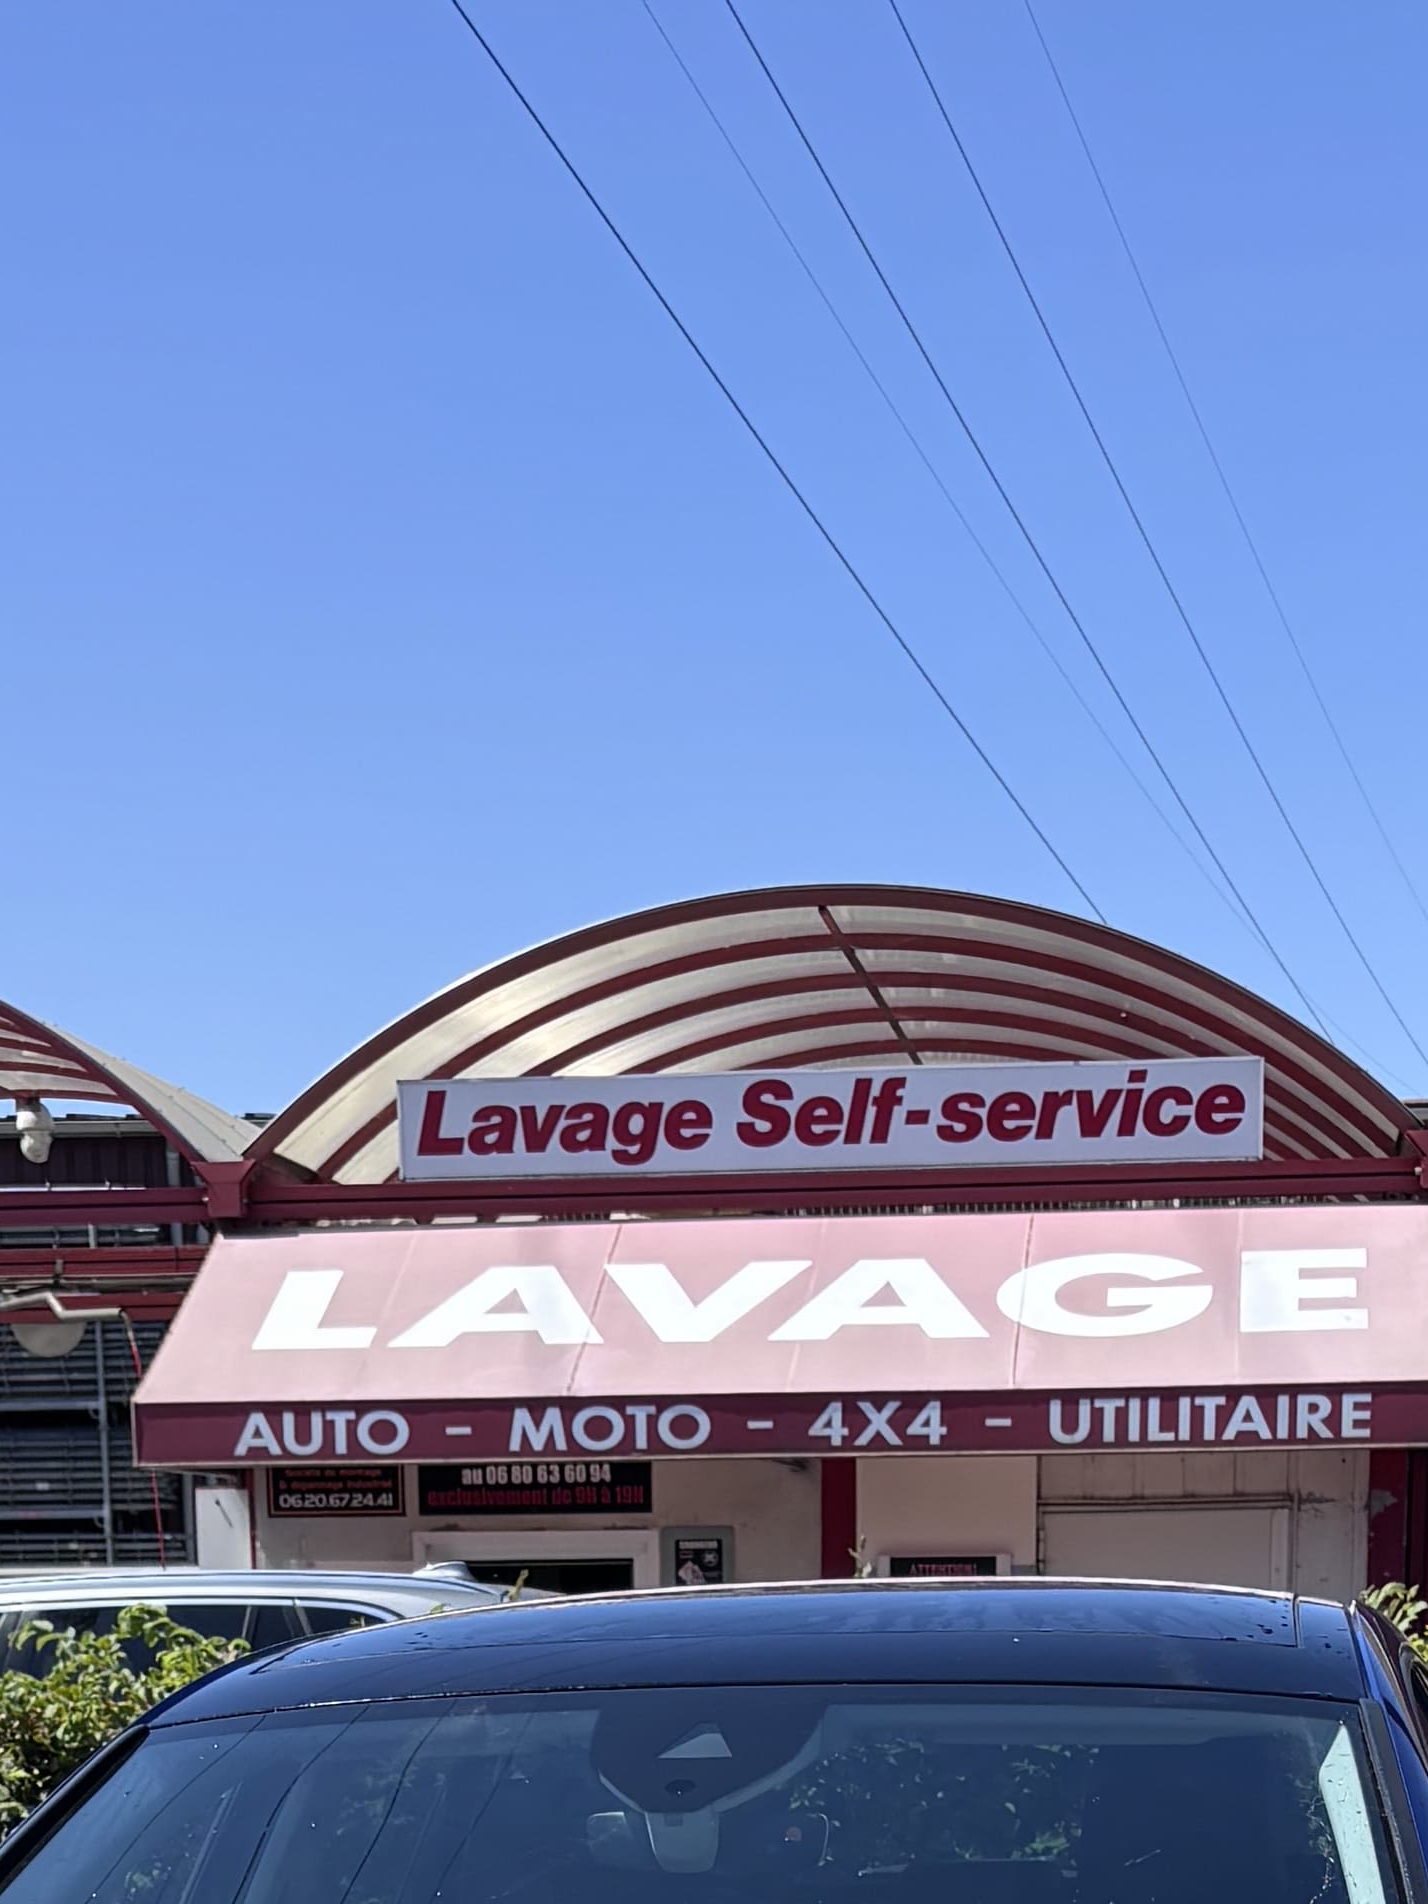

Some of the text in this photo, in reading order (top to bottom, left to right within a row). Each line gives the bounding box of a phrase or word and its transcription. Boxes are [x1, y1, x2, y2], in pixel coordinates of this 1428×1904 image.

[419, 1071, 1244, 1165] Lavage Self-service
[251, 1247, 1369, 1351] LAVAGE
[234, 1410, 410, 1456] AUTO
[509, 1404, 711, 1452] MOTO
[808, 1401, 948, 1446] 4X4
[1049, 1393, 1372, 1444] UTILITAIRE
[427, 1487, 547, 1506] exclusivement
[552, 1487, 571, 1504] de
[462, 1469, 483, 1485] au
[486, 1465, 508, 1485] 06
[537, 1464, 560, 1483] 63
[564, 1464, 586, 1483] 60
[590, 1463, 611, 1482] 94
